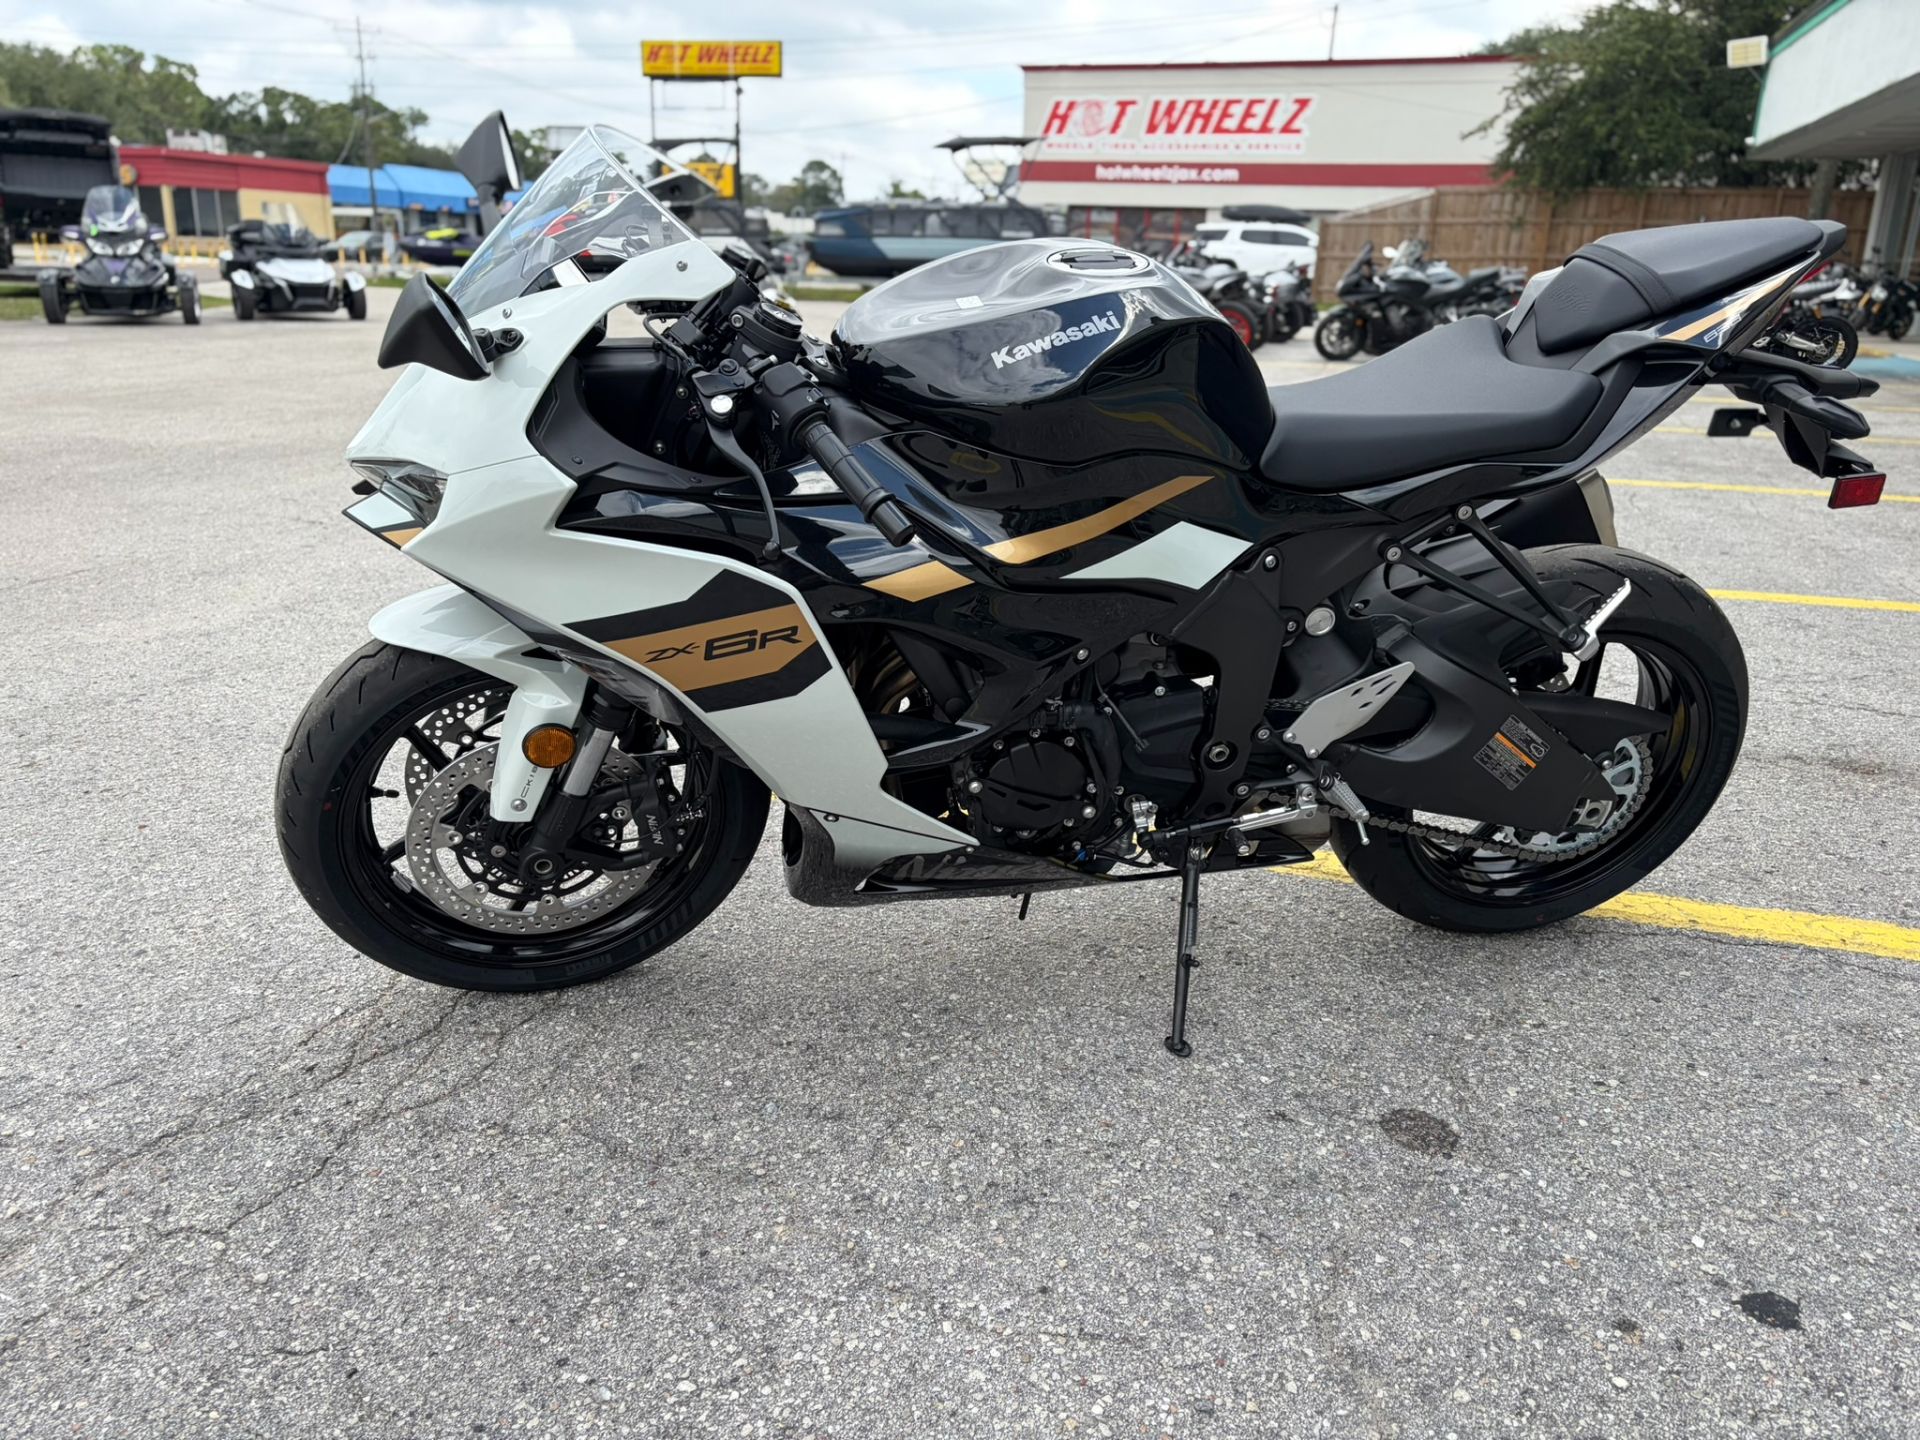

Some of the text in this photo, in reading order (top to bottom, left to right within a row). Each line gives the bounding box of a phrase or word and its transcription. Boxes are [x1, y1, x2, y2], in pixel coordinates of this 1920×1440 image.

[697, 44, 776, 64] WHEELZ
[1145, 98, 1312, 134] WHEELZ
[990, 310, 1122, 370] Kawasaki
[644, 624, 802, 664] ZX-6R
